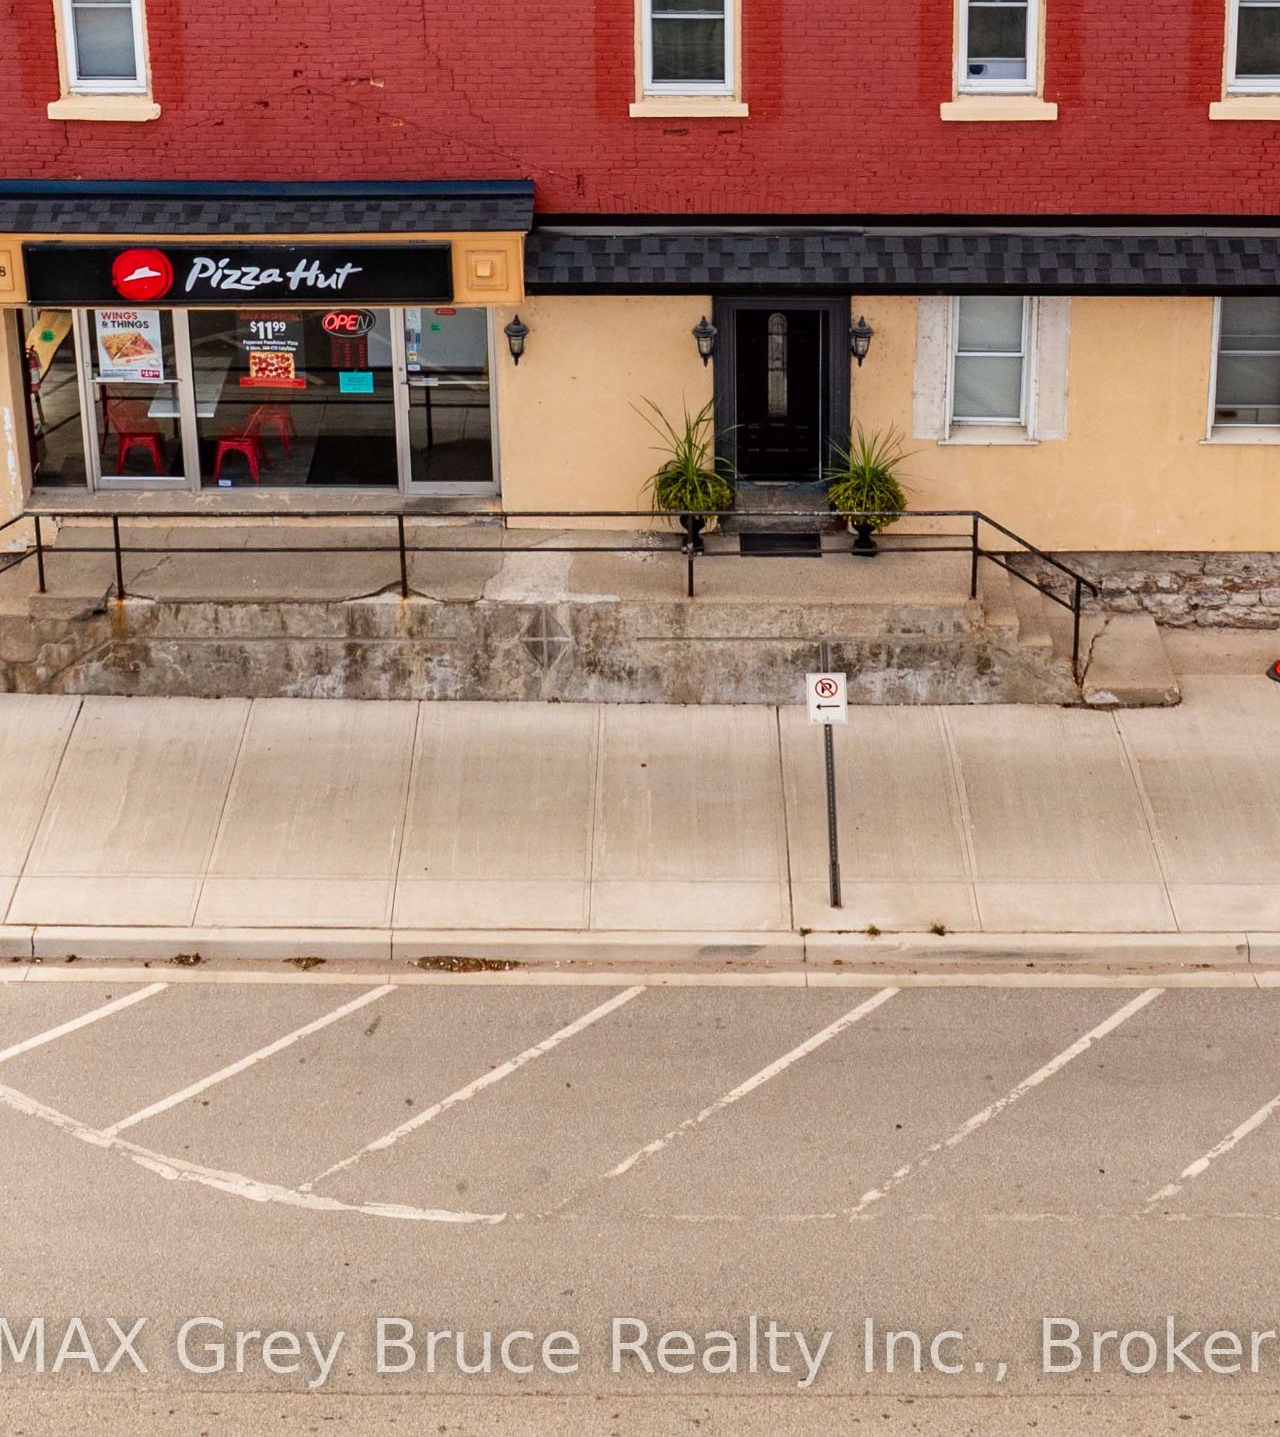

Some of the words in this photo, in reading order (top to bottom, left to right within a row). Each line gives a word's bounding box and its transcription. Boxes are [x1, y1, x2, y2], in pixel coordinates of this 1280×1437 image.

[185, 256, 283, 292] Pizza
[286, 258, 363, 290] Hut
[101, 311, 138, 320] WINGS
[111, 320, 150, 329] THINGS
[324, 314, 370, 330] OPEN
